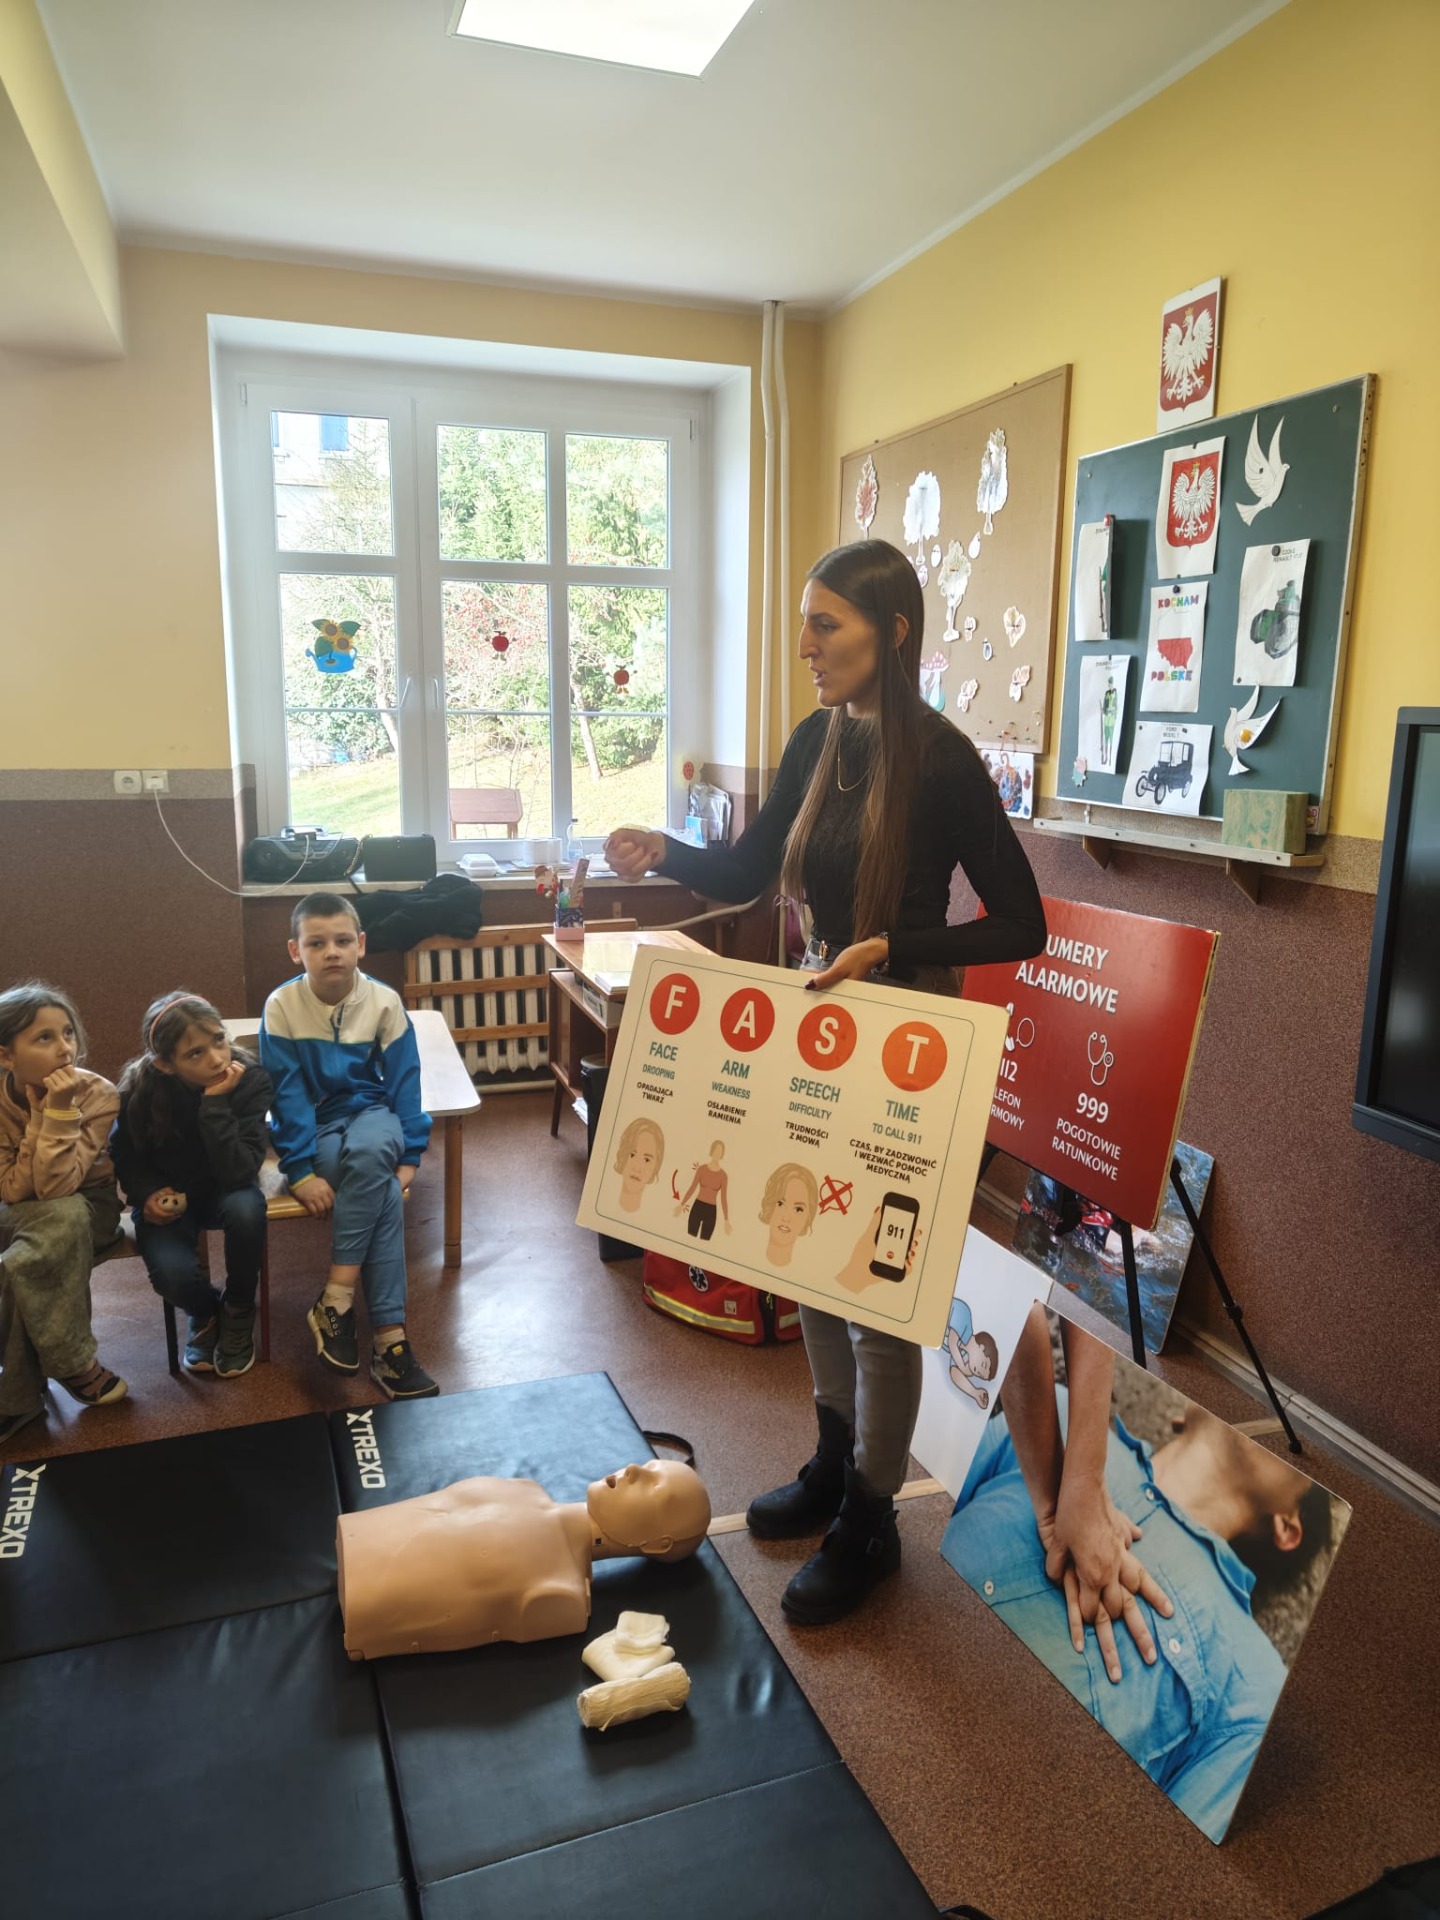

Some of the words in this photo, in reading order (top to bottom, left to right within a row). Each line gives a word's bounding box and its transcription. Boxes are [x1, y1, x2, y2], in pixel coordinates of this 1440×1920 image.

[1158, 595, 1199, 609] KOCHAM
[1046, 934, 1109, 970] UMERY
[1015, 961, 1119, 1014] ALARMOWE
[664, 983, 687, 1019] F
[732, 1001, 757, 1038] A
[814, 1016, 840, 1055] S
[906, 1034, 930, 1074] T
[649, 1041, 678, 1061] FACE
[642, 1064, 675, 1080] DROOPING
[721, 1060, 750, 1079] ARM
[1000, 1057, 1018, 1082] 112
[637, 1082, 673, 1097] OPADAJĄCA
[642, 1092, 664, 1104] TWARZ
[711, 1081, 750, 1099] WEAKNESS
[789, 1077, 841, 1103] SPEECH
[994, 1087, 1021, 1111] LEFON
[707, 1100, 747, 1117] OSŁABIENIE
[708, 1110, 741, 1125] RAMIENIA
[789, 1101, 832, 1120] DIFFICULTY
[885, 1100, 920, 1123] TIME
[990, 1104, 1025, 1131] RMOWY
[1076, 1092, 1109, 1124] 999
[785, 1121, 829, 1139] TRUDNOŚCI
[789, 1132, 795, 1140] Z
[795, 1134, 820, 1148] MOWĄ
[872, 1123, 883, 1134] TO
[885, 1126, 905, 1141] CALL
[907, 1132, 922, 1145] 911
[1056, 1117, 1121, 1160] POGOTOWIE
[850, 1139, 872, 1152] CZAS,
[874, 1145, 884, 1155] BY
[885, 1147, 937, 1169] ZADZWONIĆ
[854, 1150, 858, 1158] I
[859, 1151, 895, 1167] WEZWAĆ
[896, 1163, 928, 1177] POMOC
[1052, 1138, 1119, 1181] RATUNKOWE
[866, 1163, 911, 1184] MEDYCZNĄ
[886, 1223, 905, 1241] 911
[346, 1409, 386, 1489] XTREXO
[0, 1463, 47, 1559] XTREXO
